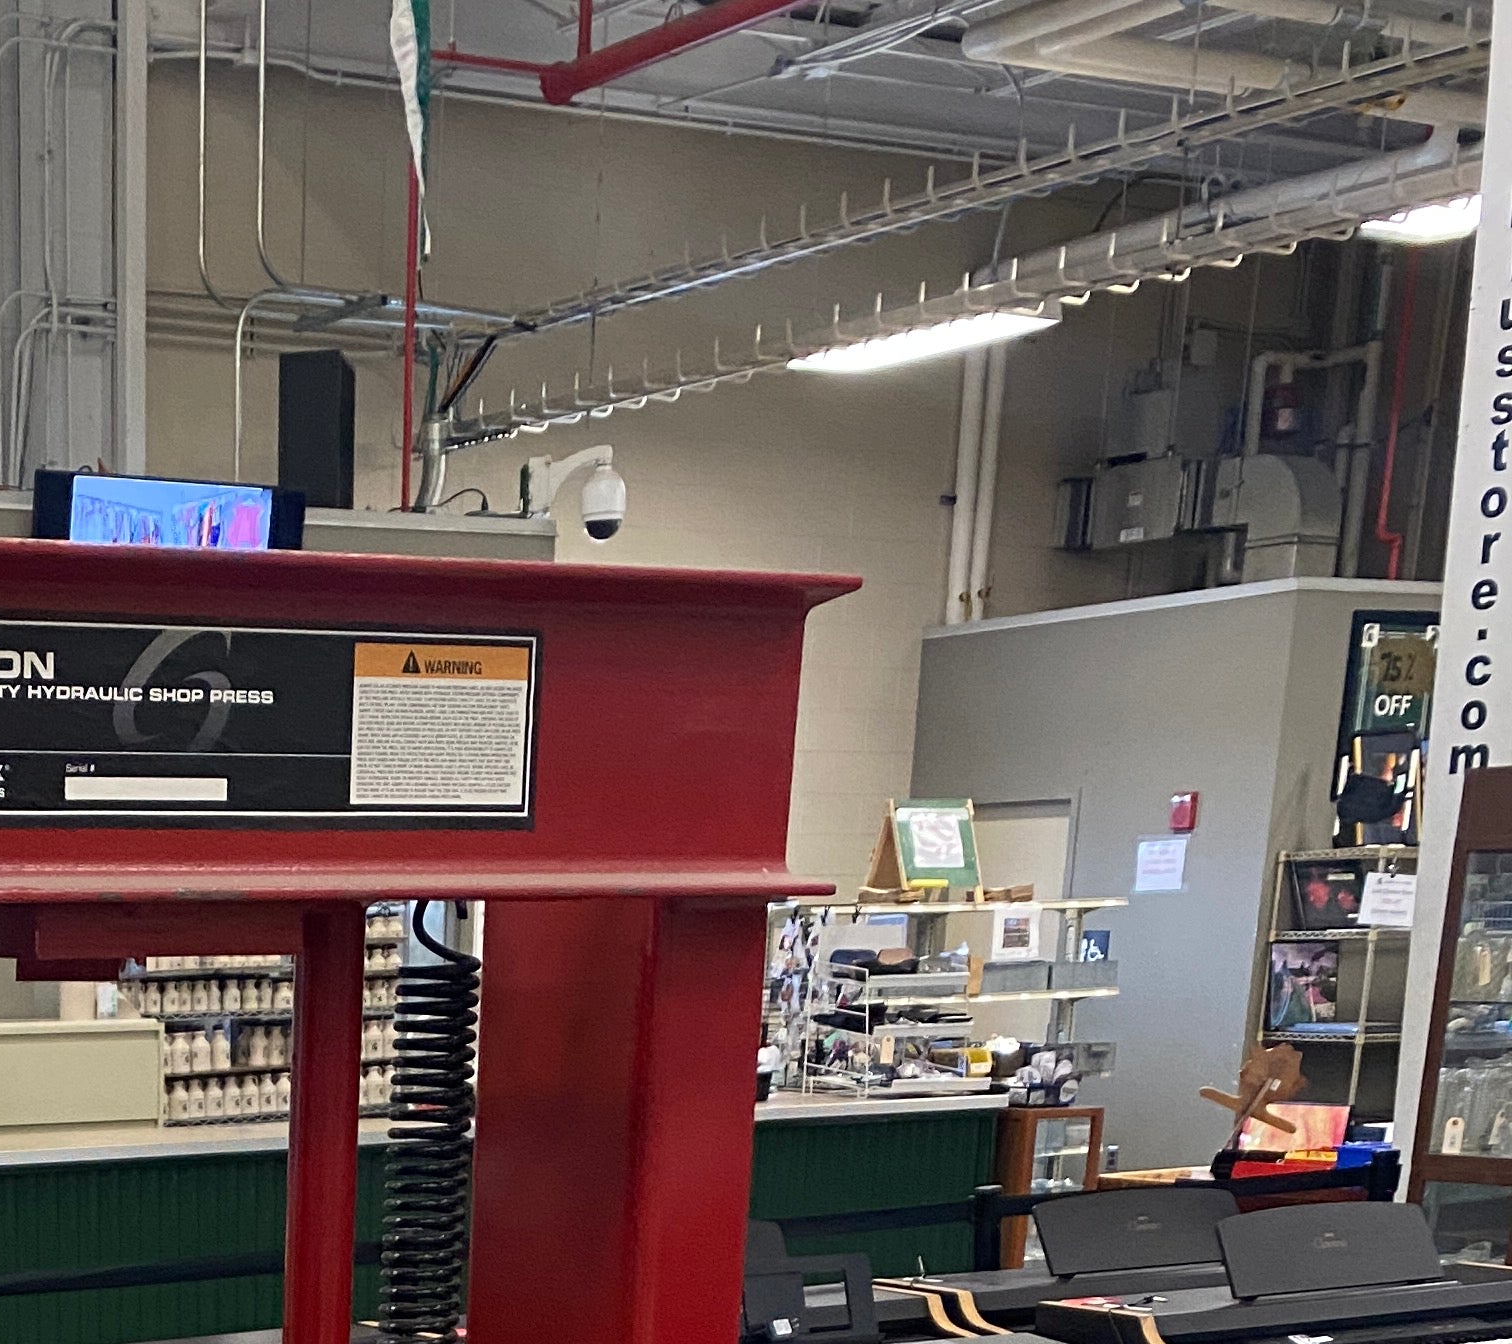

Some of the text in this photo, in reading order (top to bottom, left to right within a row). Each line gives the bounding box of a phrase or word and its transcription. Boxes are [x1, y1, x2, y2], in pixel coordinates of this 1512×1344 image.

[424, 659, 483, 675] WARNING
[28, 685, 143, 702] HYDRAULIC
[149, 687, 204, 703] SHOP
[210, 689, 274, 704] PRESS
[1374, 694, 1413, 717] OFF
